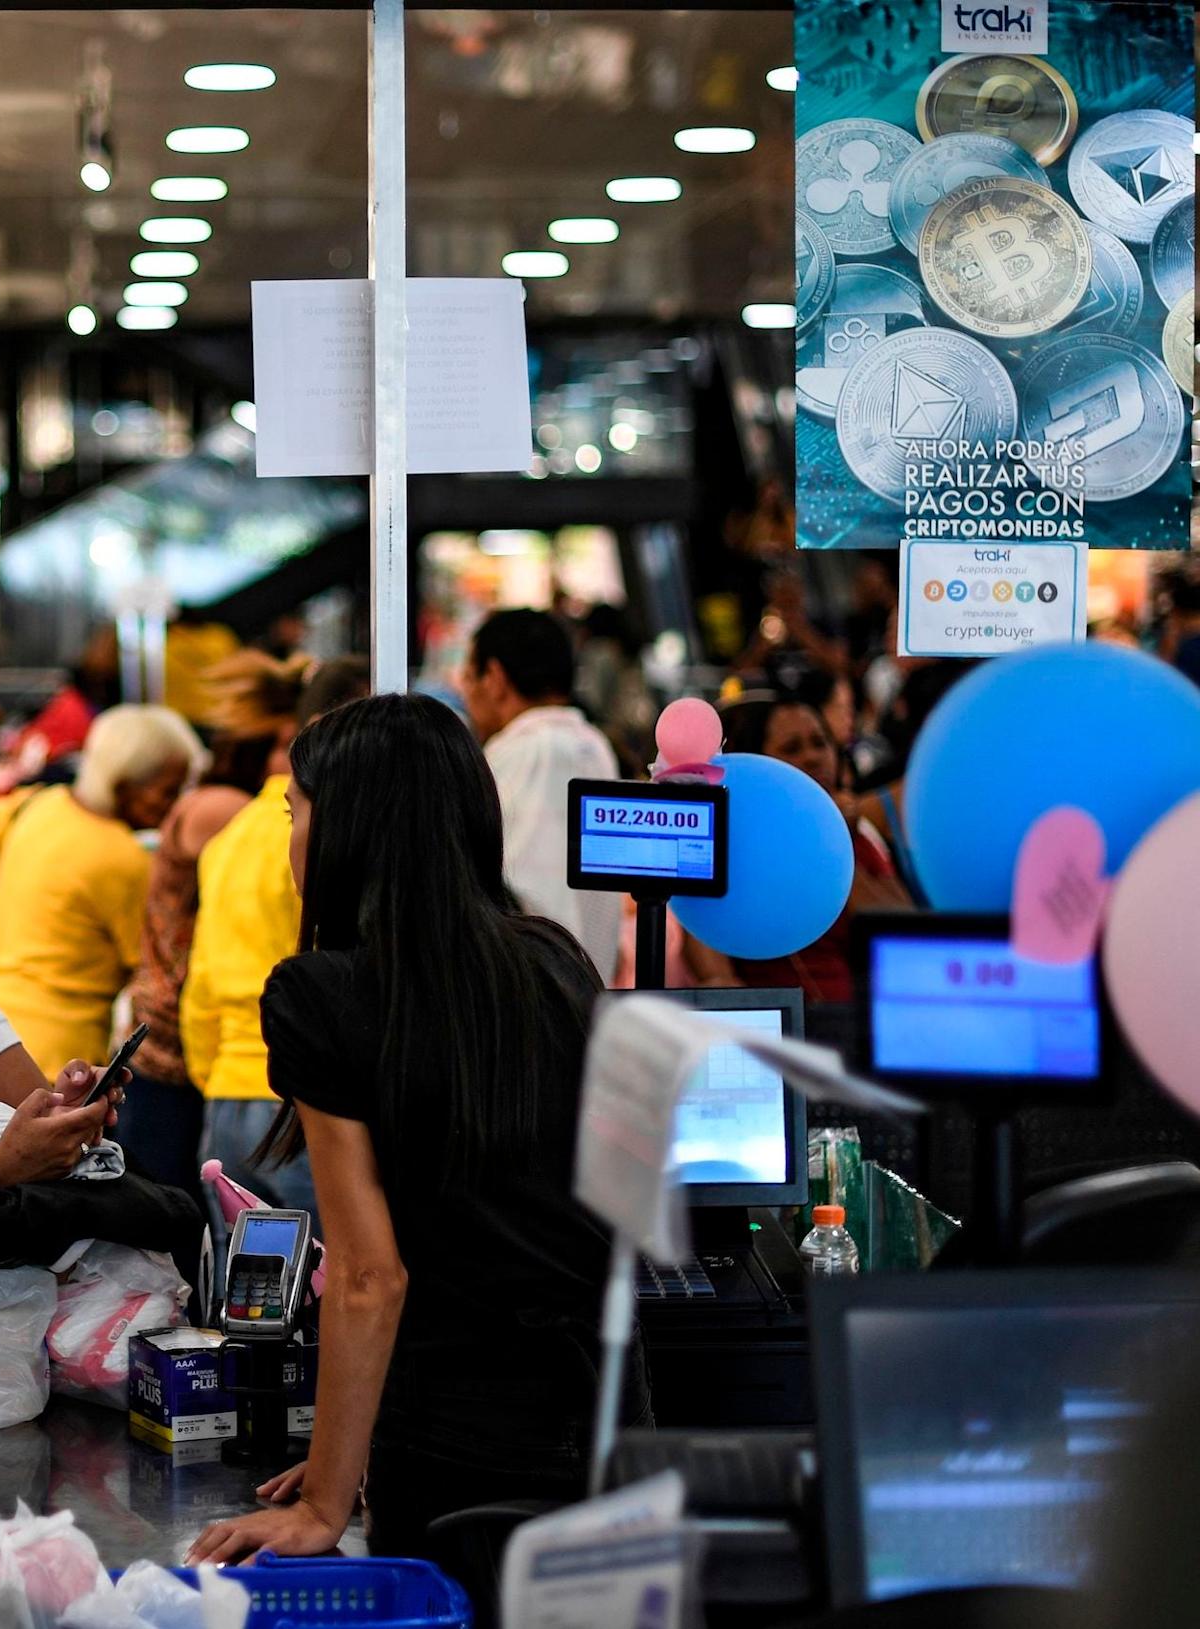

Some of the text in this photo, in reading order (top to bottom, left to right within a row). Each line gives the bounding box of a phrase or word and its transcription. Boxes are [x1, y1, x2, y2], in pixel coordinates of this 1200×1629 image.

[955, 4, 1034, 32] traki
[943, 178, 997, 209] BITCOIN
[905, 435, 1086, 460] AHORA PODRÁS
[905, 464, 1085, 488] REALIZAR TUS
[905, 490, 1084, 517] PAGOS CON
[904, 518, 1084, 537] CRIPTOMONEDAS
[974, 549, 1011, 561] traki
[594, 807, 699, 829] 912,240.00
[138, 1379, 162, 1406] PLUS
